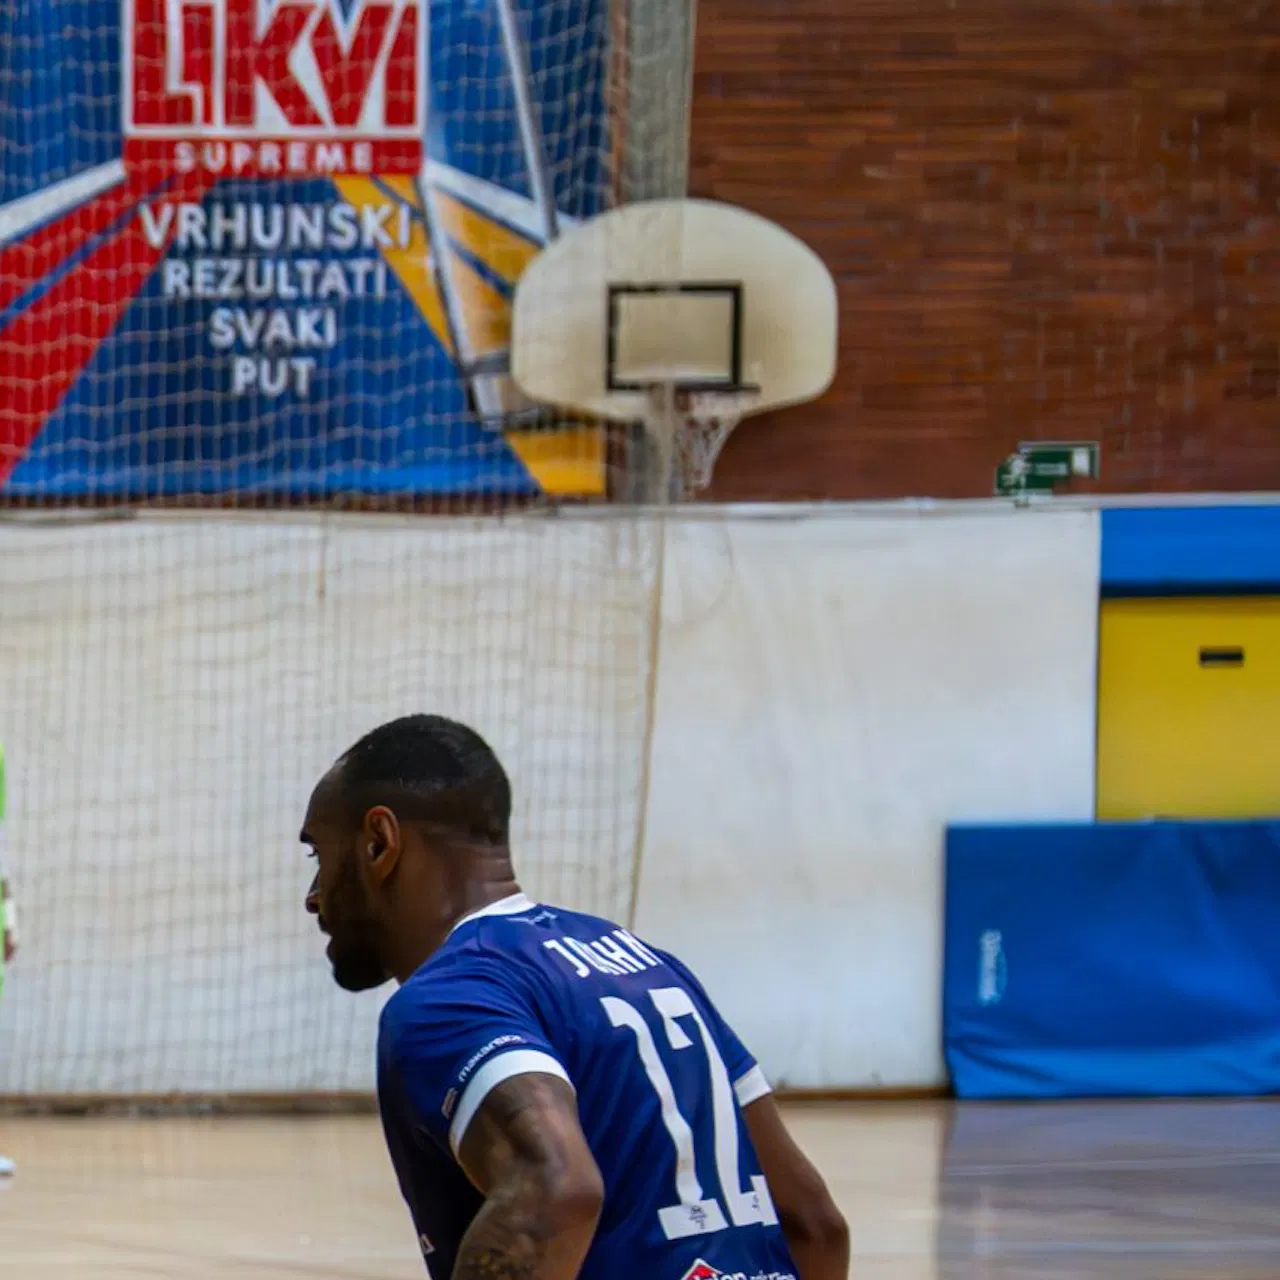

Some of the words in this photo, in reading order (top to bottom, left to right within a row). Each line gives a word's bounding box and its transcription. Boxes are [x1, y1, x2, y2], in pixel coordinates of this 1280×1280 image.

[174, 142, 374, 172] SUPREME
[140, 203, 411, 248] VRHUNSKI
[164, 259, 387, 298] REZULTATI
[209, 308, 336, 348] SVAKI
[233, 357, 315, 396] PUT
